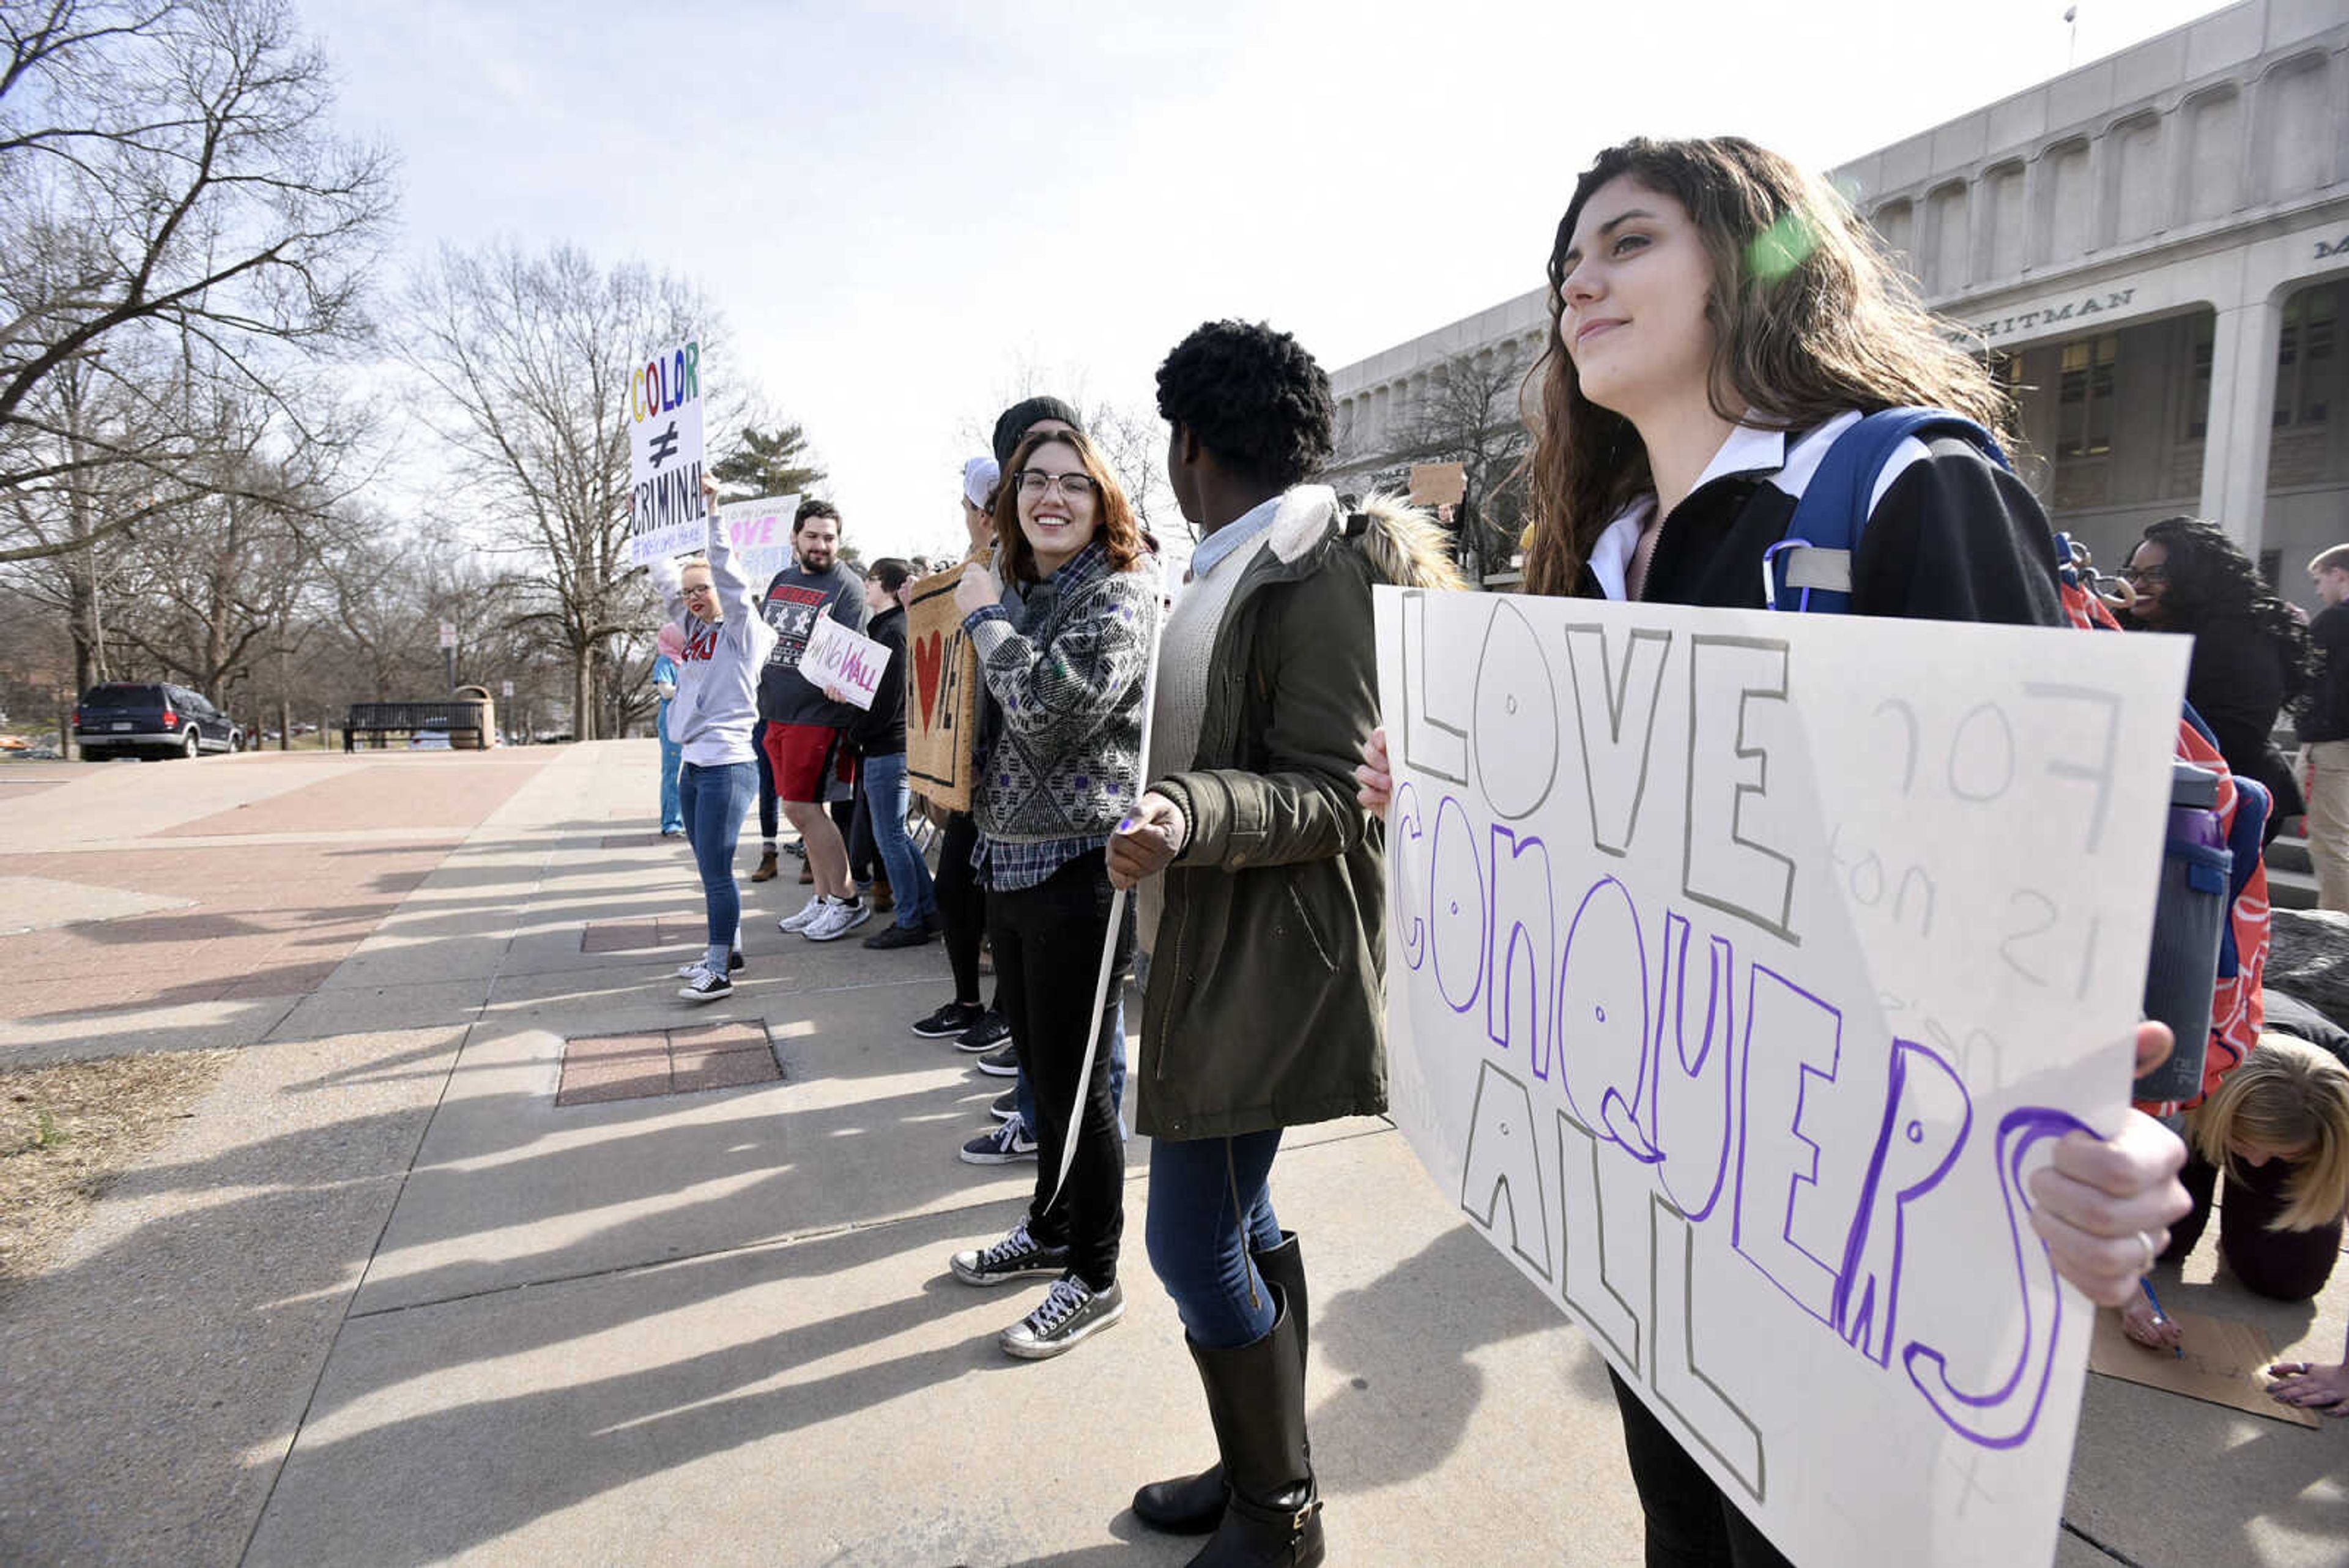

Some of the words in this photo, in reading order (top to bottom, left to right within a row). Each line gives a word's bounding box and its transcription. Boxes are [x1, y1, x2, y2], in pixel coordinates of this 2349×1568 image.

[631, 341, 699, 423] COLOR
[633, 459, 705, 537] CRIMINAL
[729, 516, 777, 546] OVE
[839, 641, 876, 694] WALL
[1403, 589, 1800, 945] LOVE
[1461, 1058, 1766, 1505] ALL
